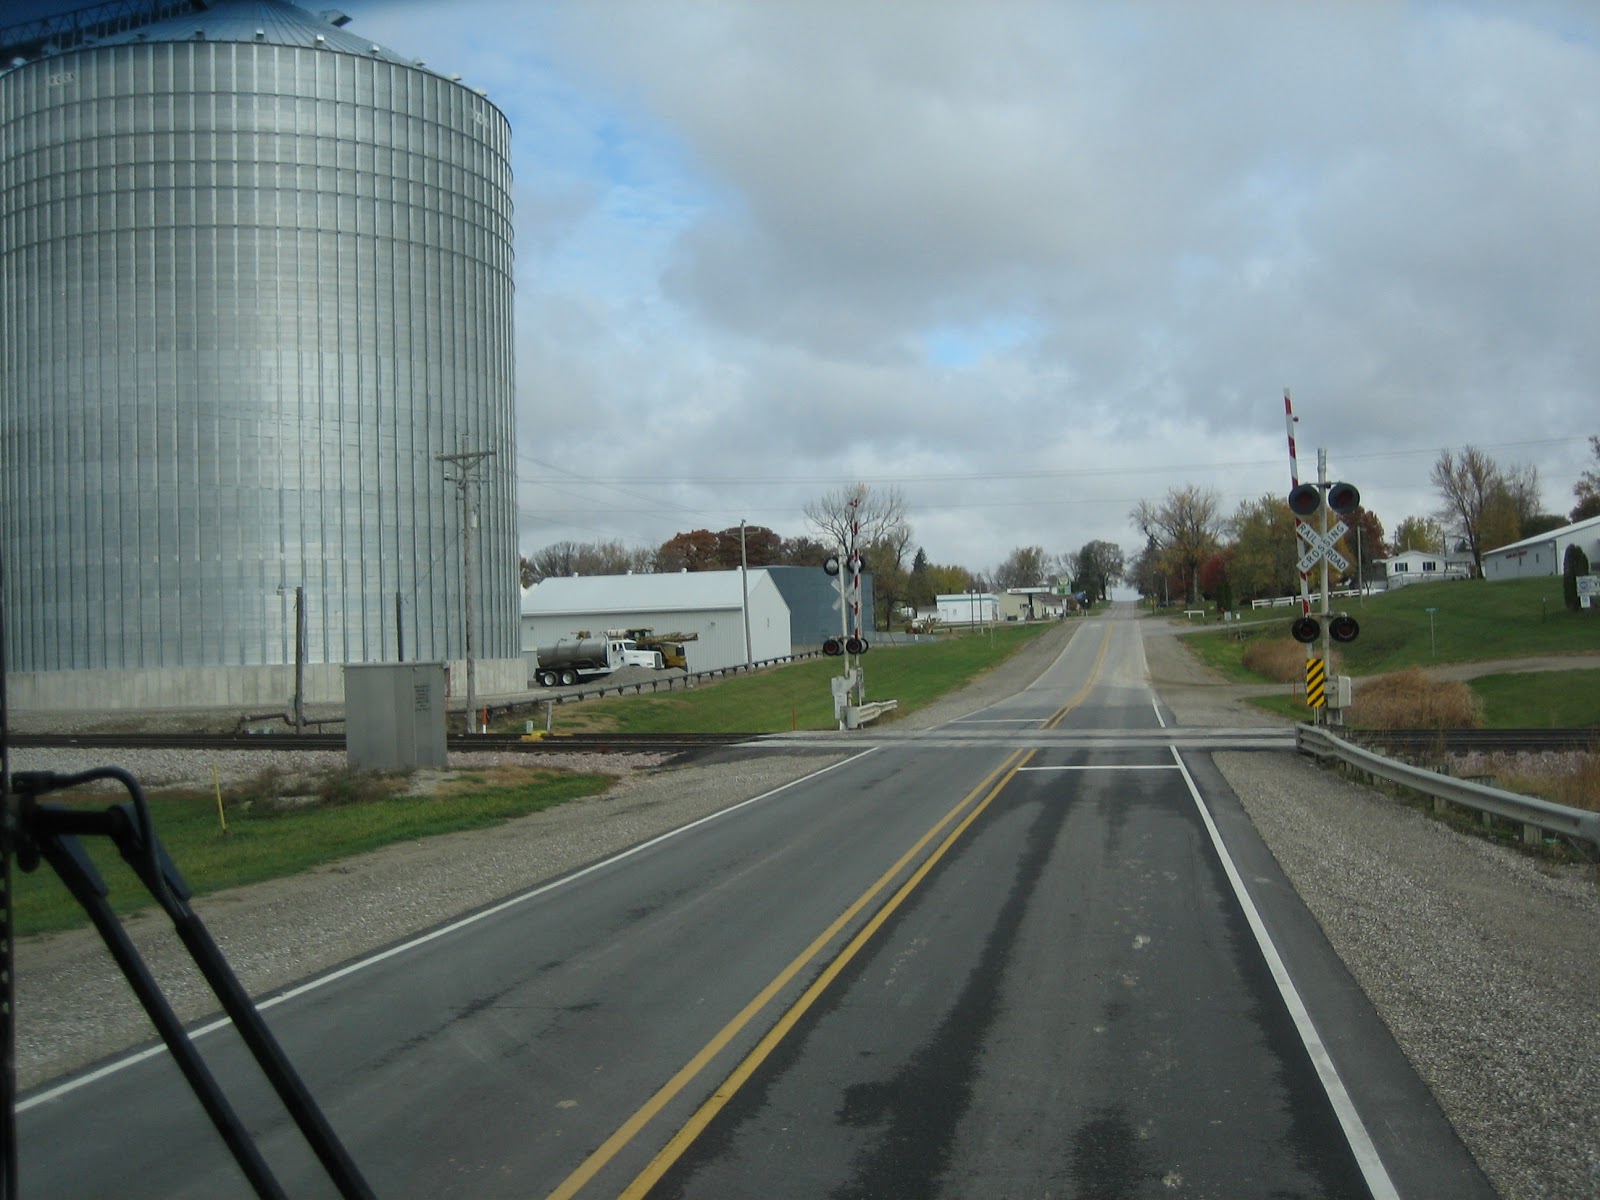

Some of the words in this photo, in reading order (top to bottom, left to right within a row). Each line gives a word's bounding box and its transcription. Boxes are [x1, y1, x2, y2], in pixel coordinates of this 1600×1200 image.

[1299, 524, 1317, 545] RAIL
[1325, 549, 1346, 570] ROAD
[1301, 524, 1345, 569] CROSSING
